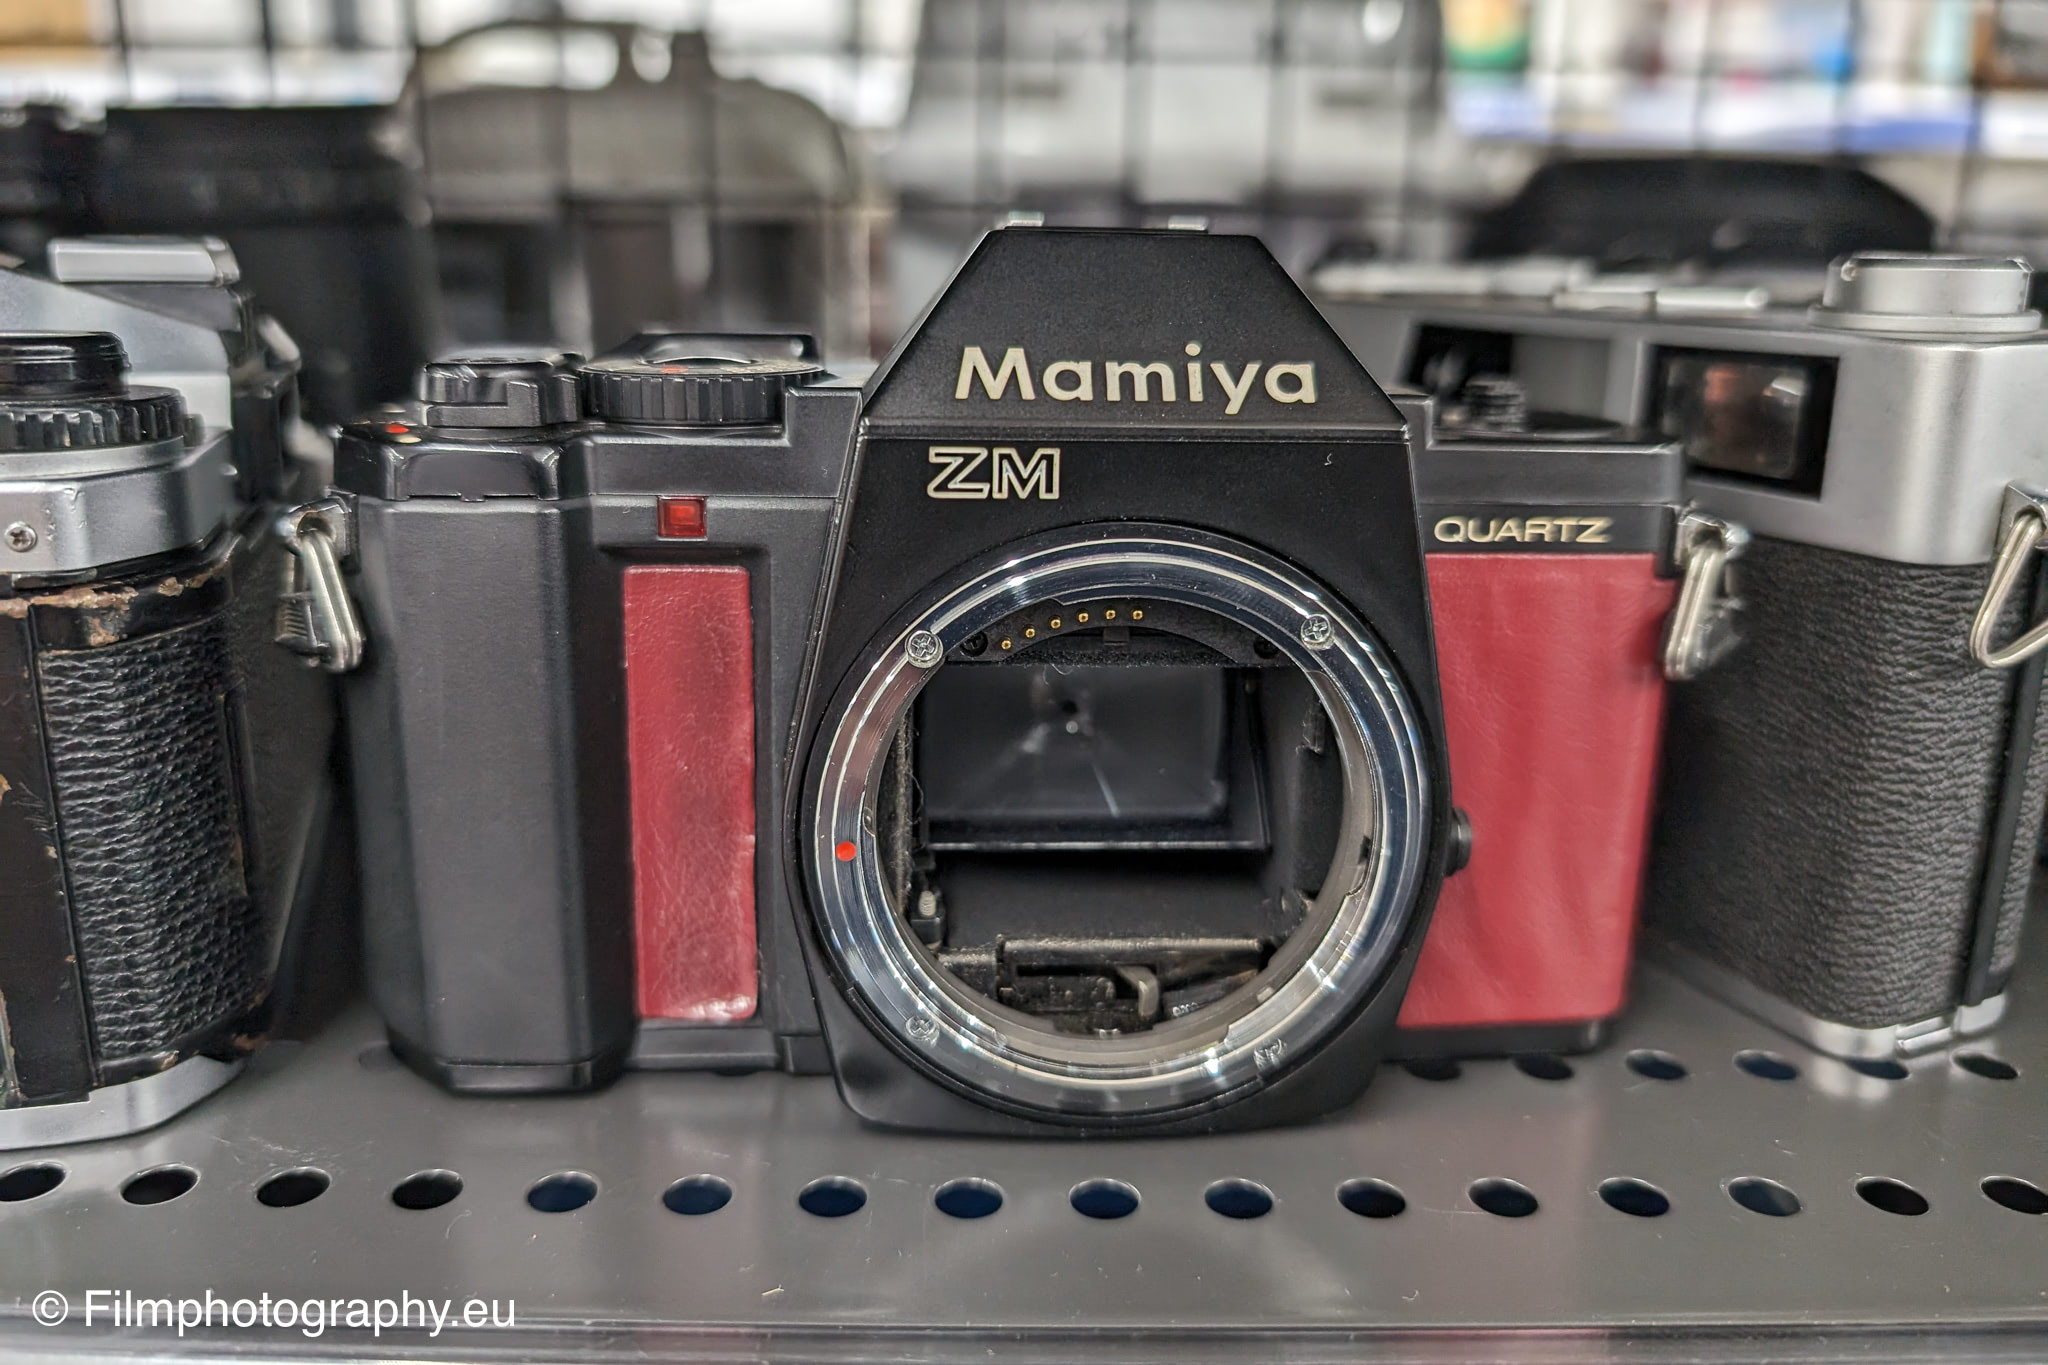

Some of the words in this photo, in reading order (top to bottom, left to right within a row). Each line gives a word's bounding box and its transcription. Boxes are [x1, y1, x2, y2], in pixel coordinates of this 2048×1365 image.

[954, 342, 1317, 415] Mamiya
[926, 446, 1061, 500] ZM
[1433, 515, 1613, 545] QUARTZ
